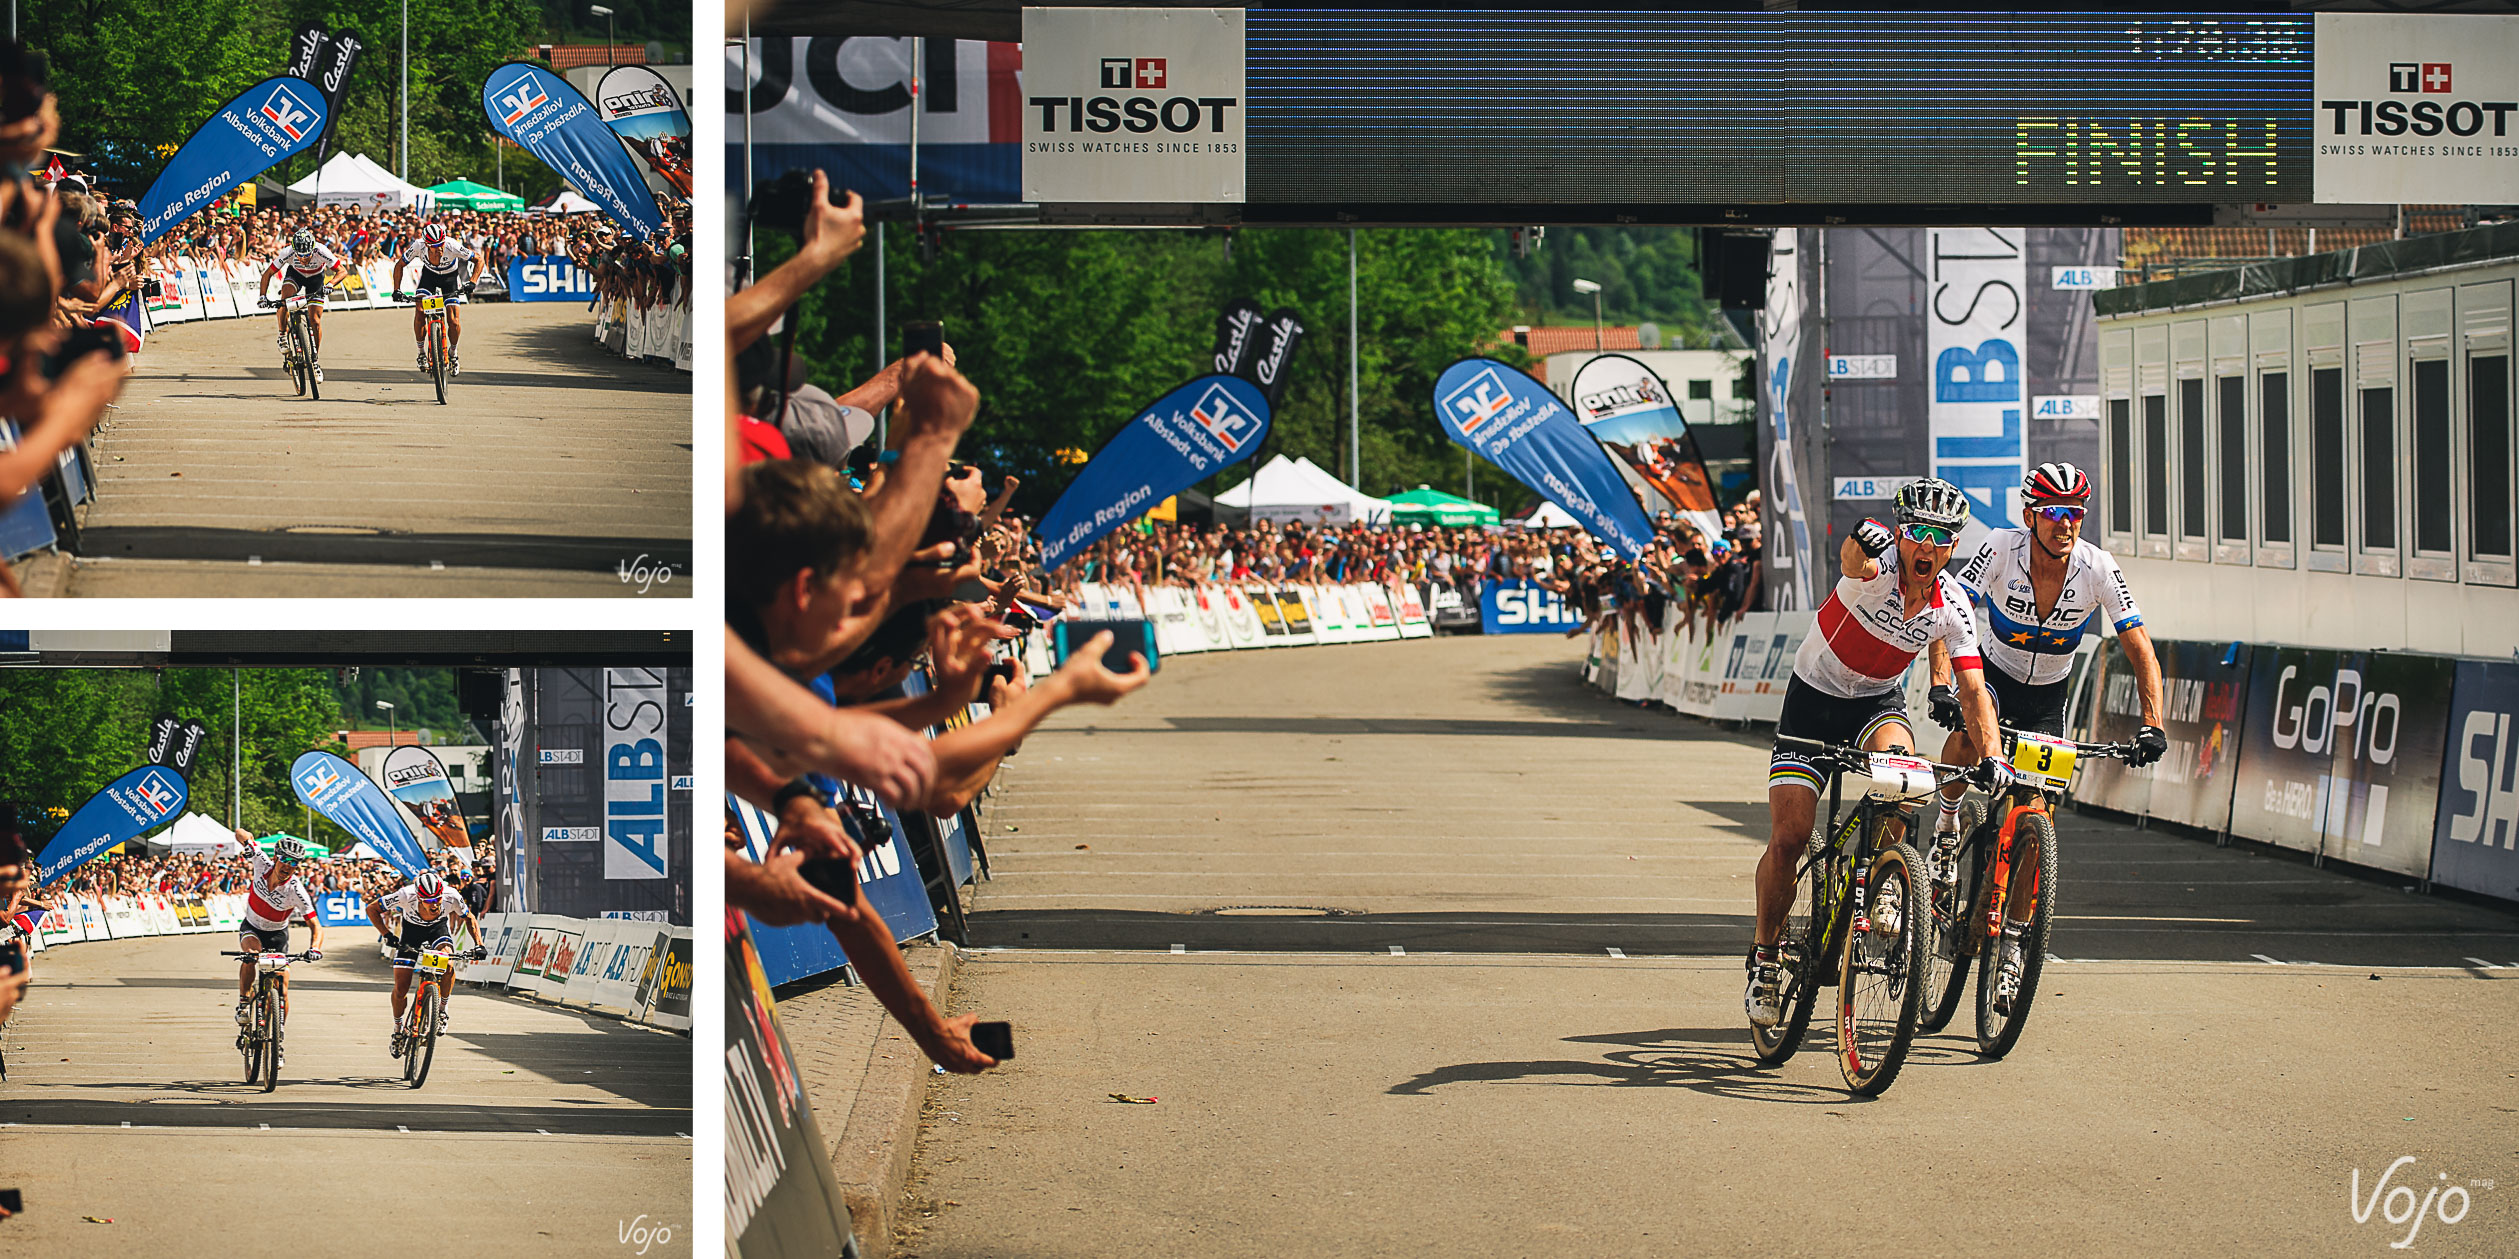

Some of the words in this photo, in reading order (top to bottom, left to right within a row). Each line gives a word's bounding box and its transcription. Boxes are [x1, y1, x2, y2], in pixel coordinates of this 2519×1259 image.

[324, 37, 354, 92] Castle
[221, 110, 264, 148] Albstadt
[261, 143, 277, 158] eG
[246, 107, 292, 152] Volksbank
[1029, 96, 1237, 134] TISSOT
[2321, 100, 2518, 137] TISSOT
[1029, 142, 1075, 154] SWISS
[1082, 142, 1150, 154] WATCHES
[1156, 142, 1200, 154] SINCE
[1207, 143, 1238, 154] 1853
[2016, 116, 2277, 185] FINISH
[2320, 145, 2365, 156] SWISS
[2371, 145, 2435, 156] WATCHES
[2442, 146, 2482, 156] SINCE
[2490, 147, 2519, 157] 1853
[141, 215, 162, 239] Für
[163, 202, 184, 222] die
[184, 170, 232, 206] Region
[430, 298, 437, 308] 3
[1256, 317, 1294, 385] Castle
[1827, 358, 1894, 376] LBSTADT
[1143, 413, 1193, 458] Albstadt
[1188, 451, 1209, 471] eG
[1171, 410, 1227, 464] Volksbank
[1040, 540, 1067, 565] Für
[1068, 521, 1095, 546] die
[1095, 484, 1152, 527] Region
[1961, 542, 1993, 584] BMC
[2273, 664, 2400, 765] GoPro
[149, 718, 173, 764] Castle
[176, 724, 200, 768] Castle
[539, 751, 582, 762] LBSTADT
[1772, 751, 1810, 763] odlo
[2036, 744, 2053, 772] 3
[608, 668, 665, 876] ALBST
[1872, 756, 1889, 766] UCI
[1900, 772, 1908, 793] 1
[106, 788, 138, 819] Albstadt
[135, 813, 149, 827] eG
[124, 786, 160, 823] Volksbank
[544, 829, 599, 840] ALBSTADT
[1834, 815, 1862, 849] SCOTT
[39, 868, 56, 883] Für
[57, 855, 73, 871] die
[74, 833, 112, 860] Region
[272, 959, 276, 968] 1
[432, 954, 439, 967] 3
[1844, 1015, 1851, 1029] DT
